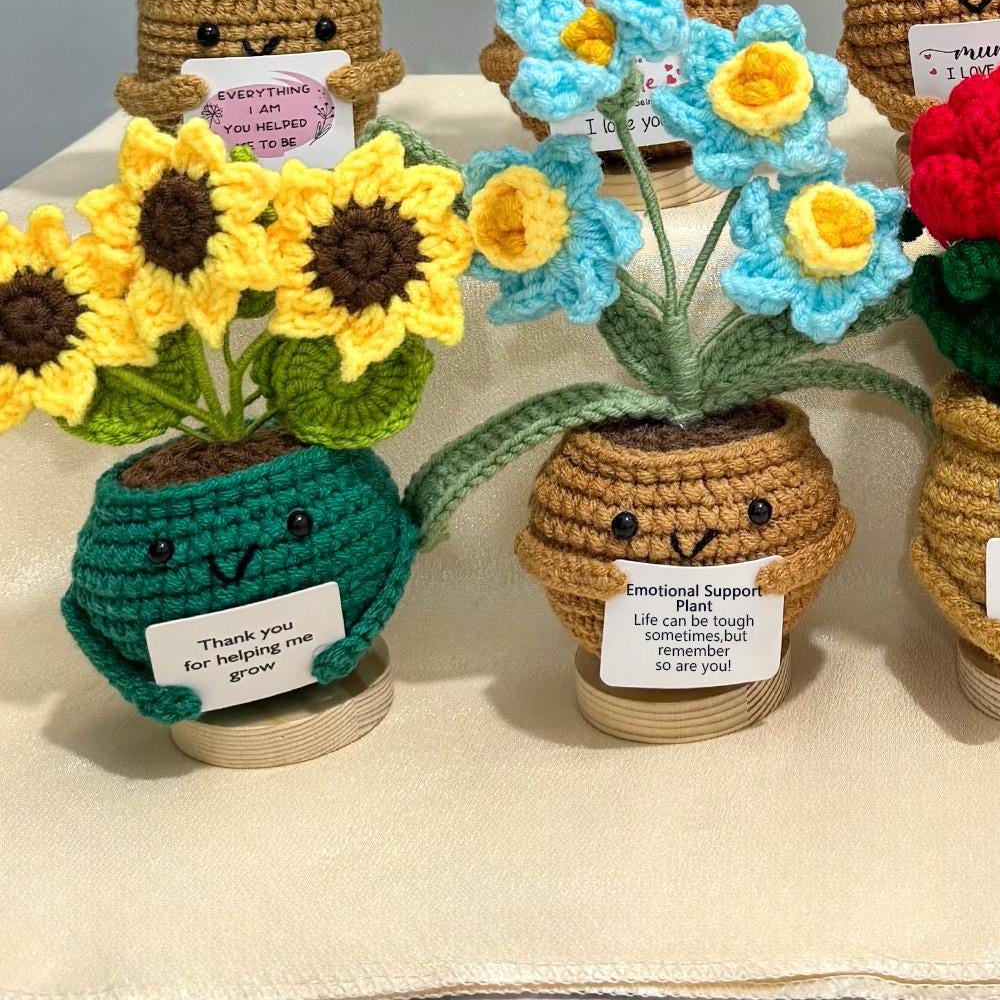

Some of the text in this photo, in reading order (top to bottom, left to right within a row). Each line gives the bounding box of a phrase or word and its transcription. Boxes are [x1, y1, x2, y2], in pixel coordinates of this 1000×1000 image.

[946, 67, 956, 80] I
[217, 84, 311, 101] EVERYTHING
[249, 104, 281, 115] I AM
[223, 118, 307, 134] YOU HELPED
[585, 115, 665, 135] I loe yo
[260, 140, 277, 150] TO
[281, 137, 297, 147] BE
[626, 583, 763, 600] Emotional Support
[676, 600, 713, 612] Plant
[634, 613, 755, 631] Life can be tough
[197, 621, 294, 651] Thank you
[644, 629, 748, 643] sometimes,but
[184, 633, 314, 672] for helping me
[658, 645, 730, 657] remember
[229, 661, 276, 683] grow
[655, 659, 732, 675] so are you!
